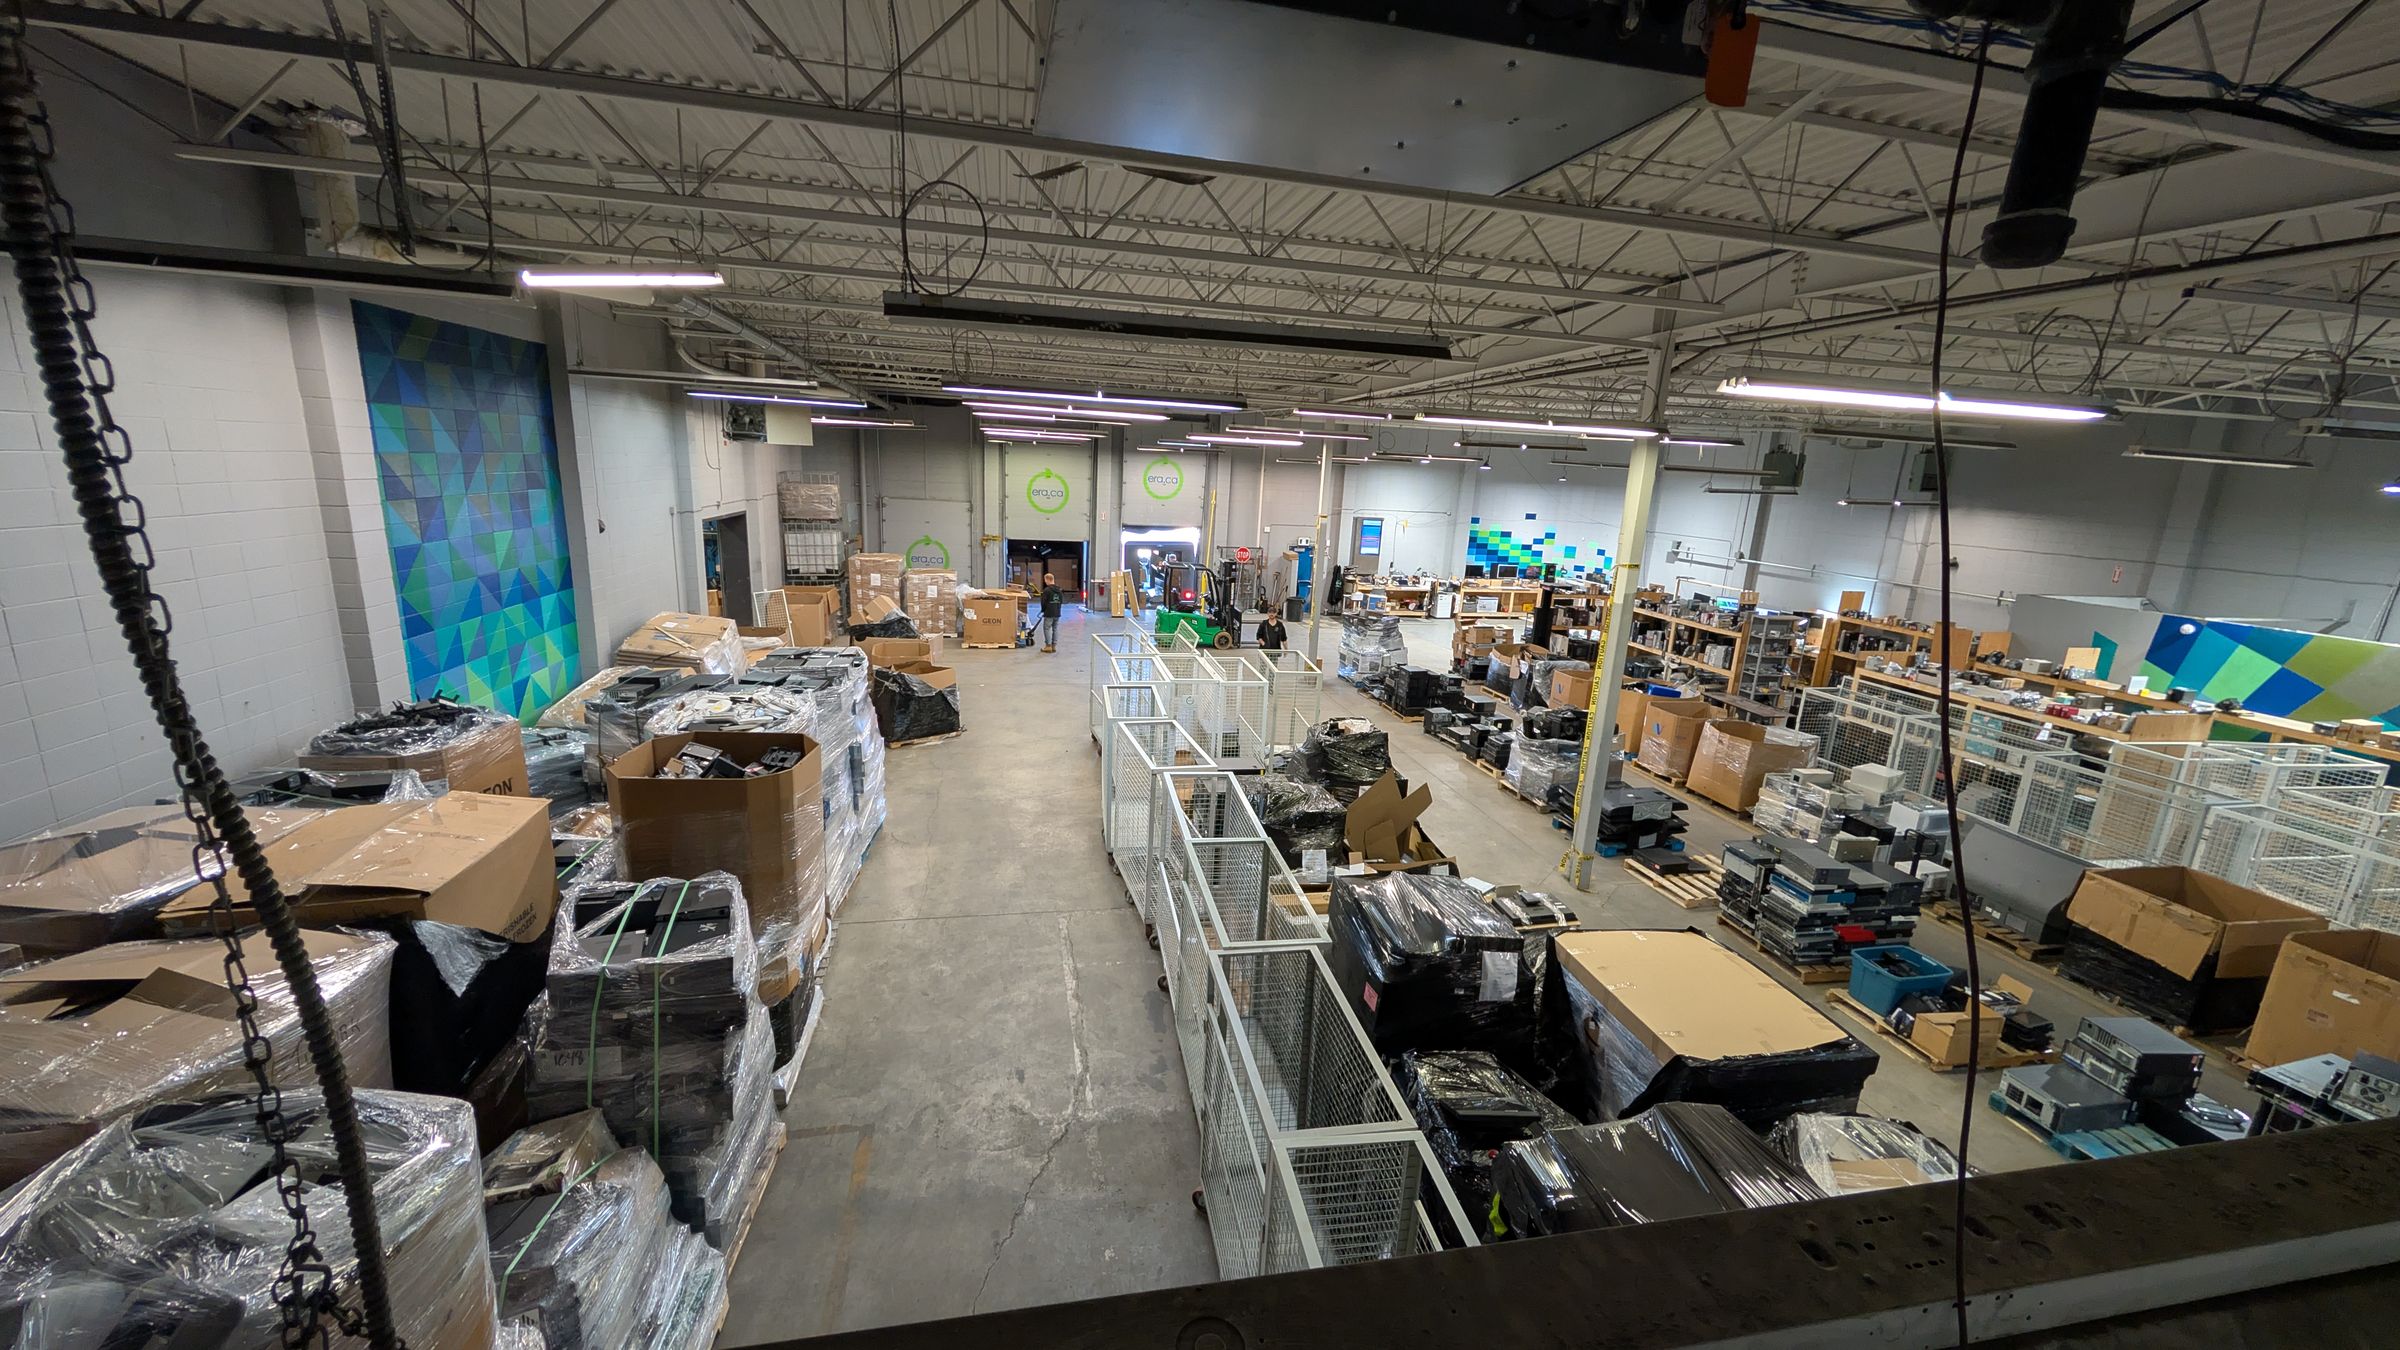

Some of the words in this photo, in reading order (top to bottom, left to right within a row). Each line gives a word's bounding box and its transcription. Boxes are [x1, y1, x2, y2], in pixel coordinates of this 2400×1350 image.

[1148, 474, 1178, 485] era.ca
[1032, 487, 1064, 498] era.ca
[911, 554, 944, 565] era.ca
[1237, 551, 1250, 559] STOP
